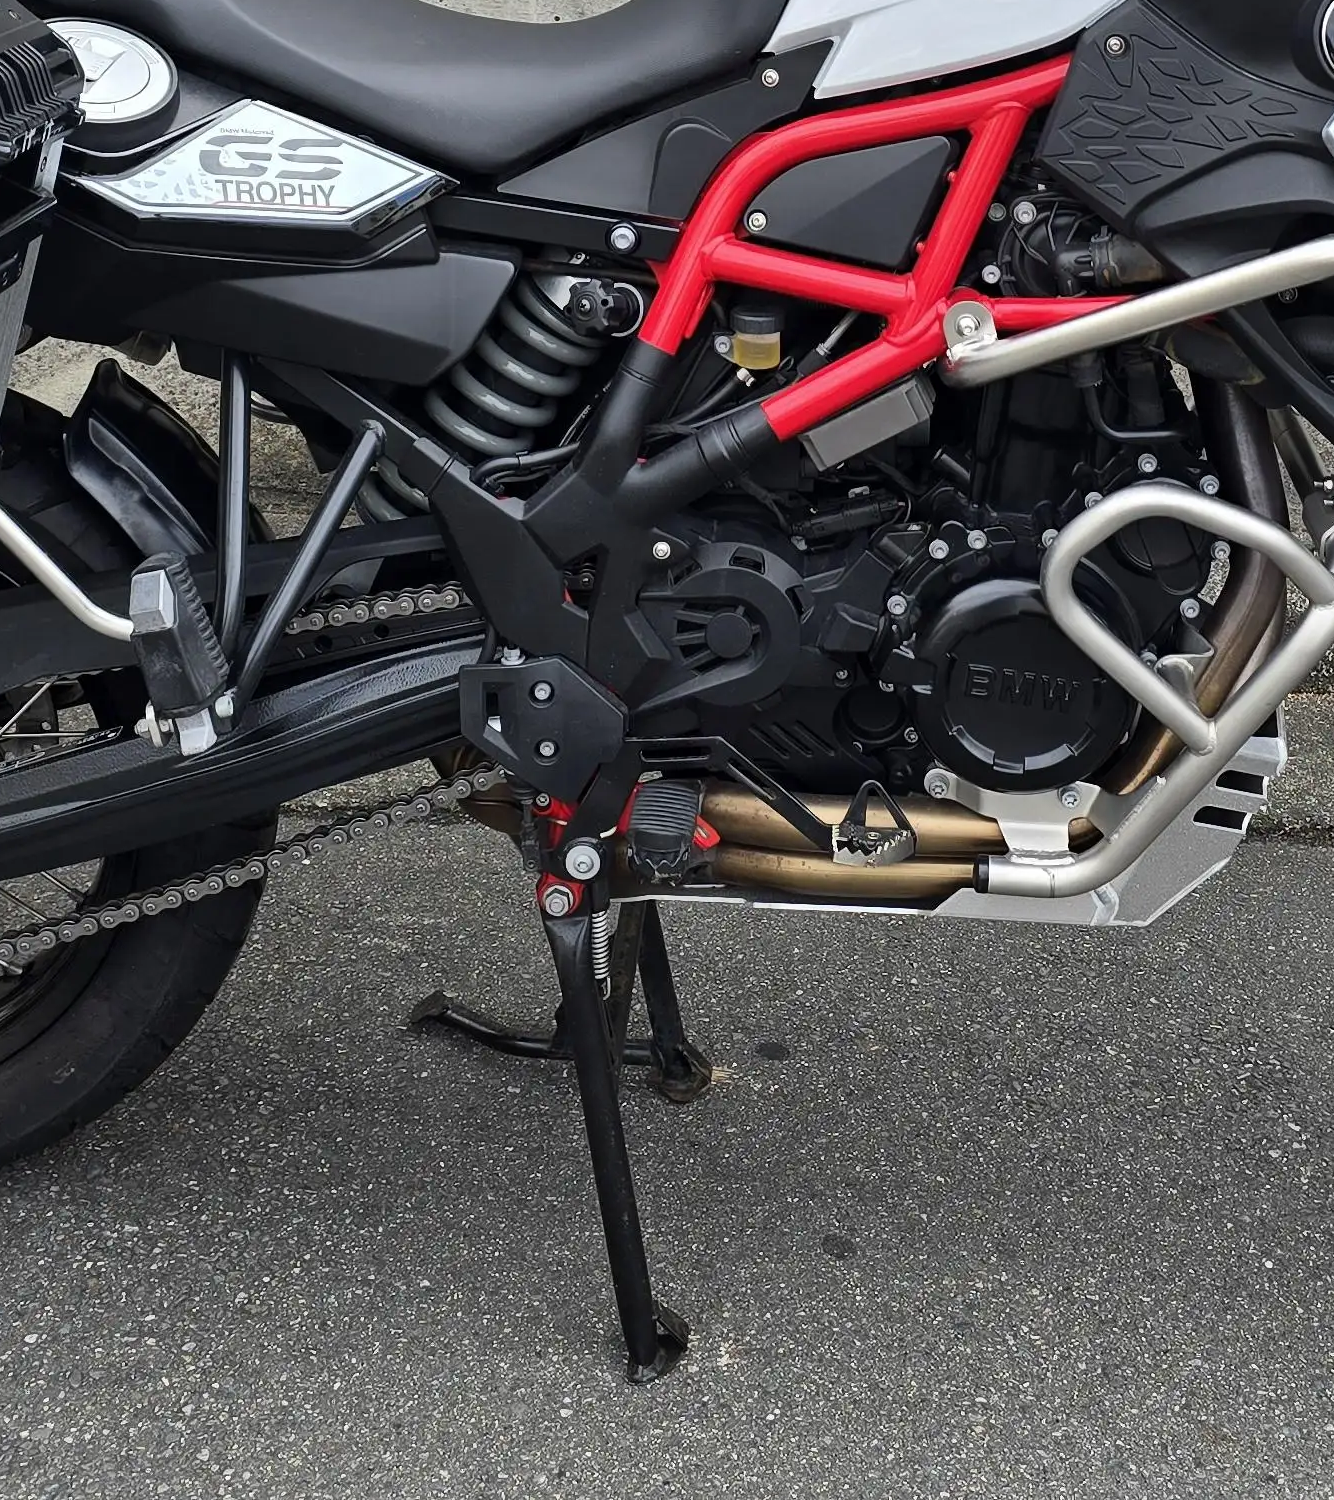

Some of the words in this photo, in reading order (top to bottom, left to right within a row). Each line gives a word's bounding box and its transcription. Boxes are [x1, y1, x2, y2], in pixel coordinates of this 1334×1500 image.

[198, 134, 345, 181] GS
[214, 178, 335, 207] TROPHY
[965, 663, 1082, 714] BMW
